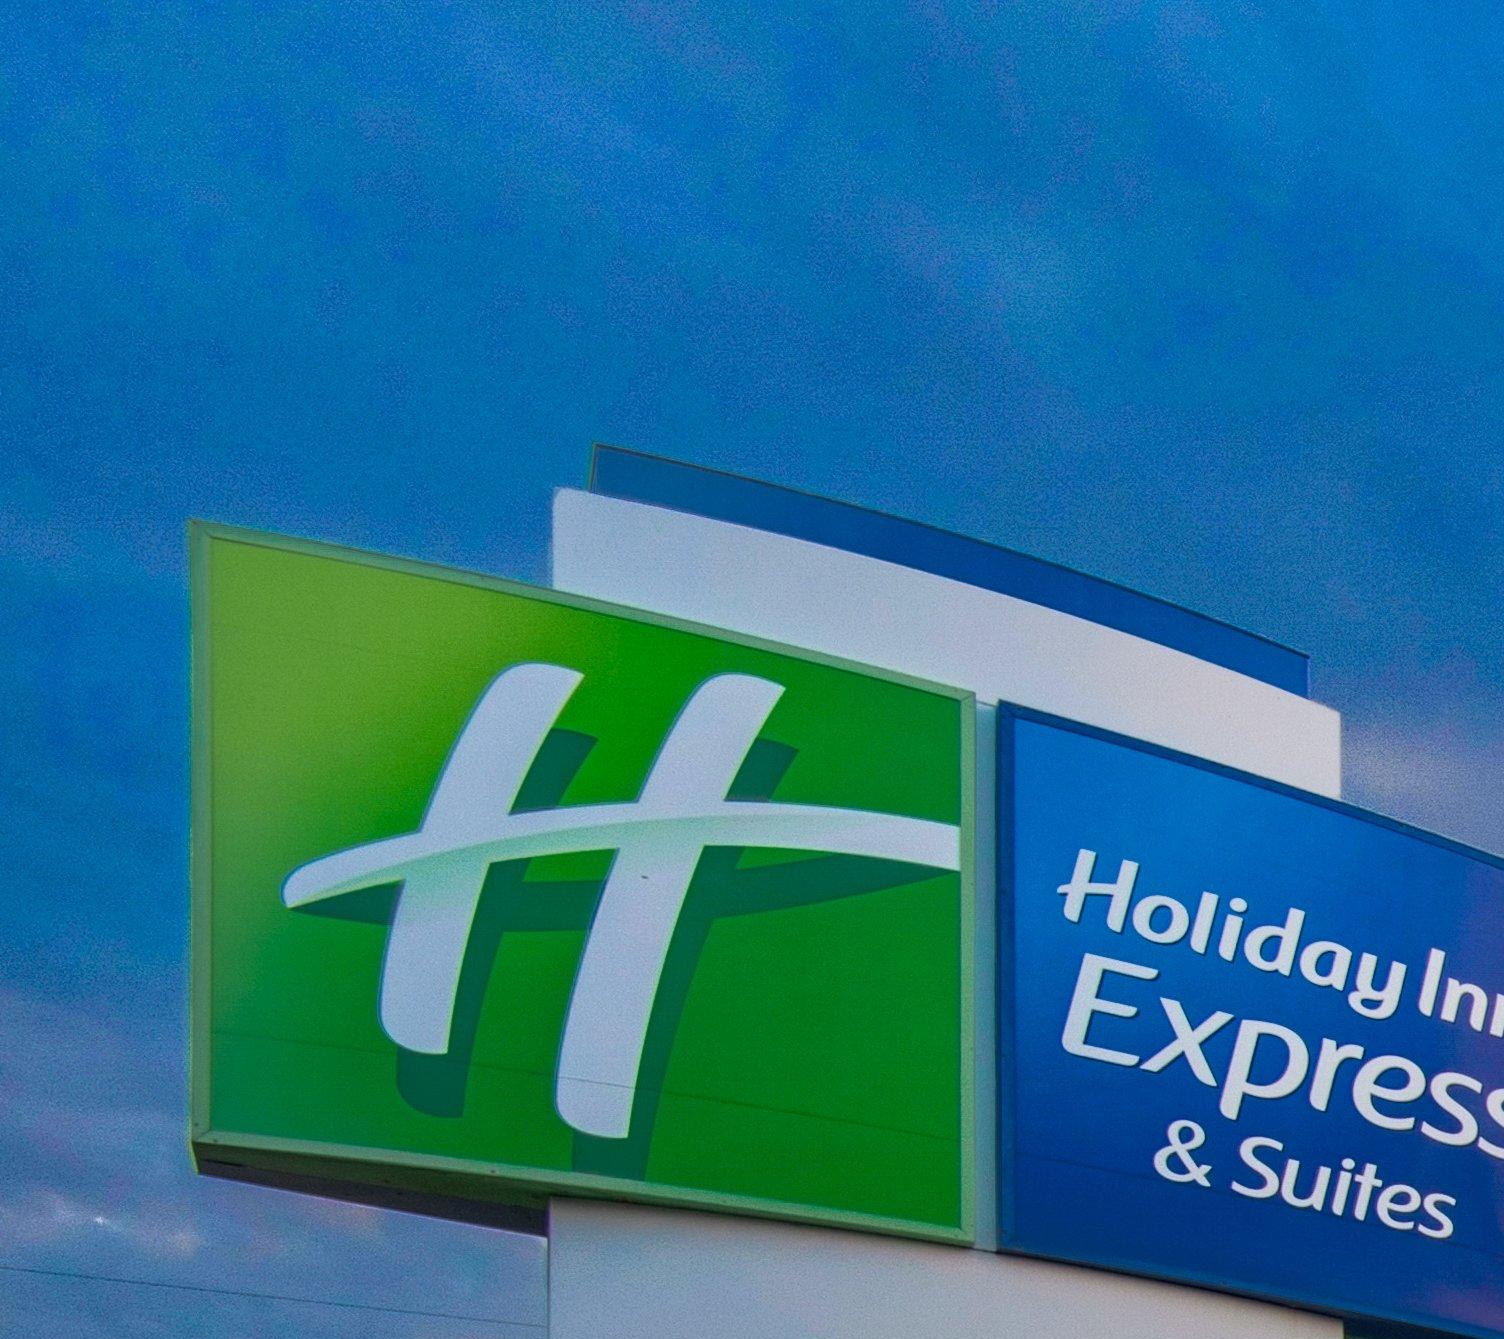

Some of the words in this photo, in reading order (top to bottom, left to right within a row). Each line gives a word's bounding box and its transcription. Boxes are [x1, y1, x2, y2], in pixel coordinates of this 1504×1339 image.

[1057, 848, 1407, 1019] Holiday
[1153, 1119, 1213, 1187] &
[1231, 1137, 1457, 1239] Suites
